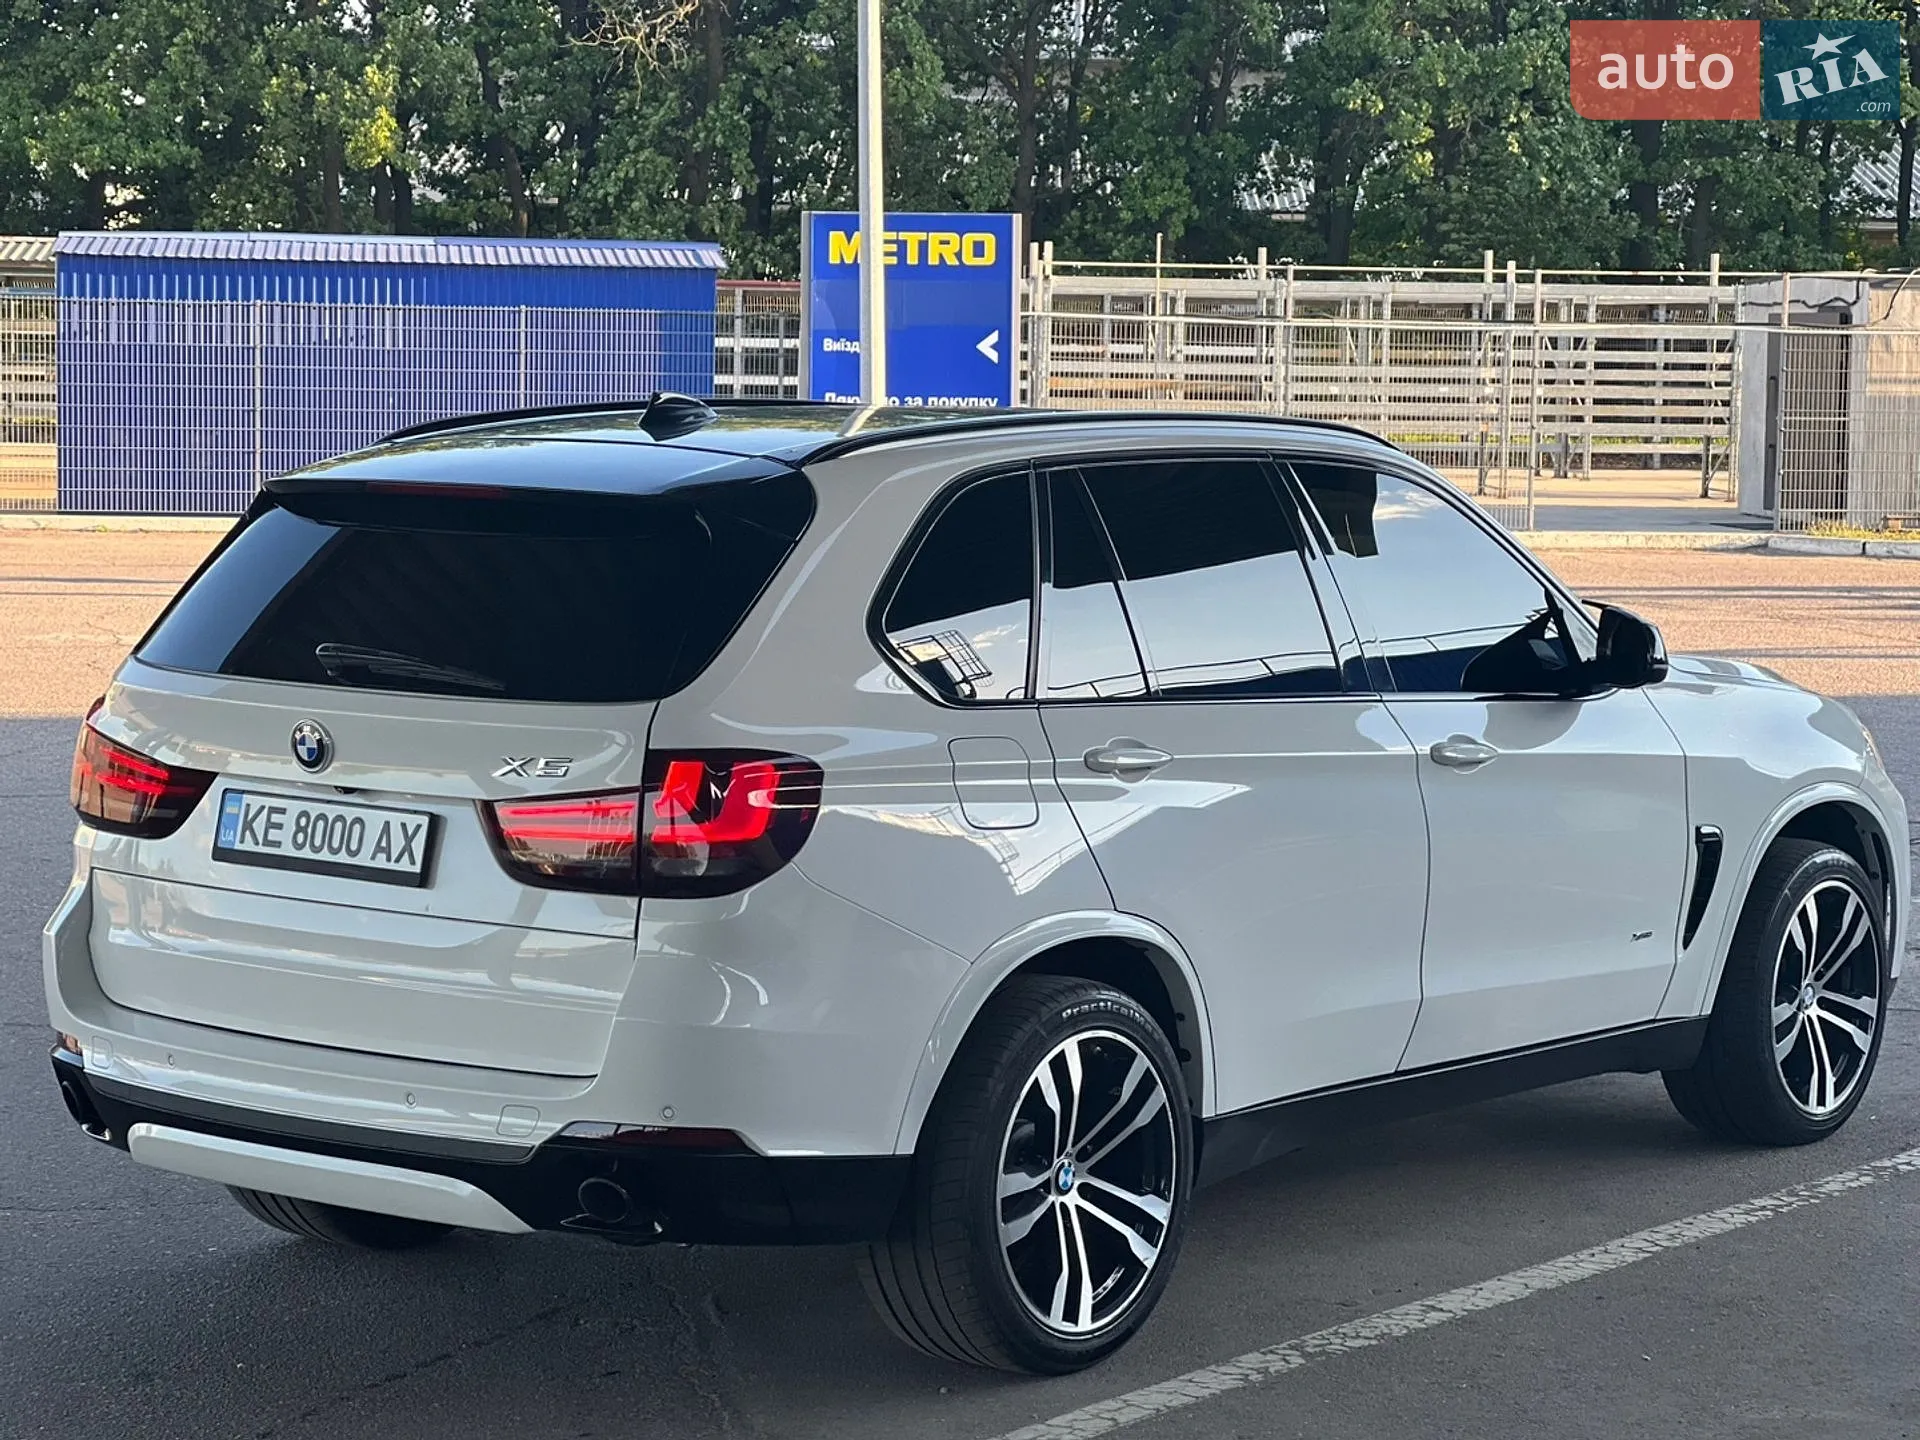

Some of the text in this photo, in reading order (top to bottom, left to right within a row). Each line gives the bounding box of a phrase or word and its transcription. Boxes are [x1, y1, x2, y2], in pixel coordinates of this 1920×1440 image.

[828, 230, 996, 266] METRO
[823, 337, 860, 354] Виїзд
[491, 757, 573, 777] X5
[239, 803, 423, 866] KE 8000 AX
